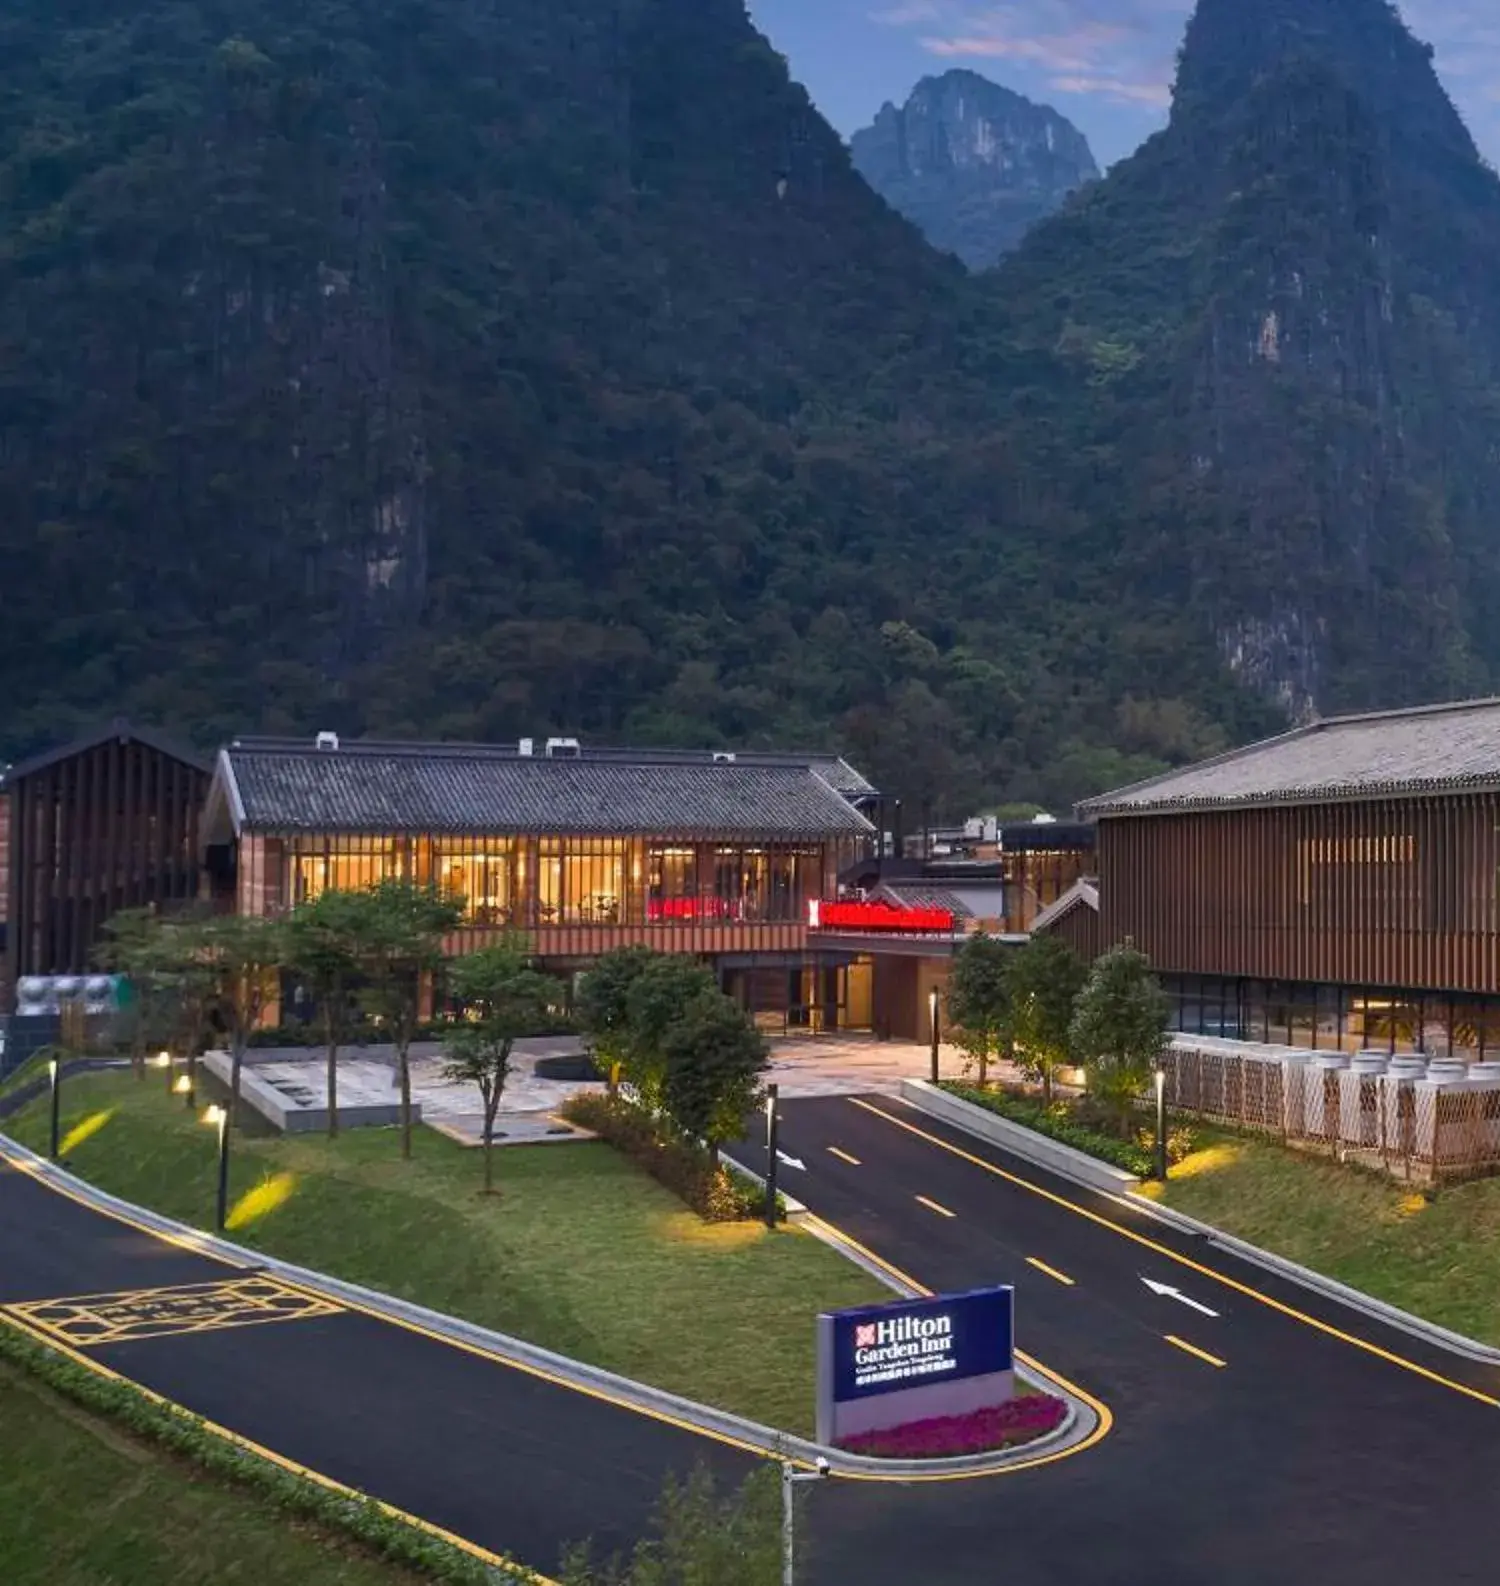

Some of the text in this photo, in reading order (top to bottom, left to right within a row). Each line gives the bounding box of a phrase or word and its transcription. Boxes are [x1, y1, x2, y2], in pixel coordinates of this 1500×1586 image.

[877, 1316, 951, 1345] Hilton
[855, 1342, 919, 1365] Garden
[921, 1337, 951, 1353] Inn
